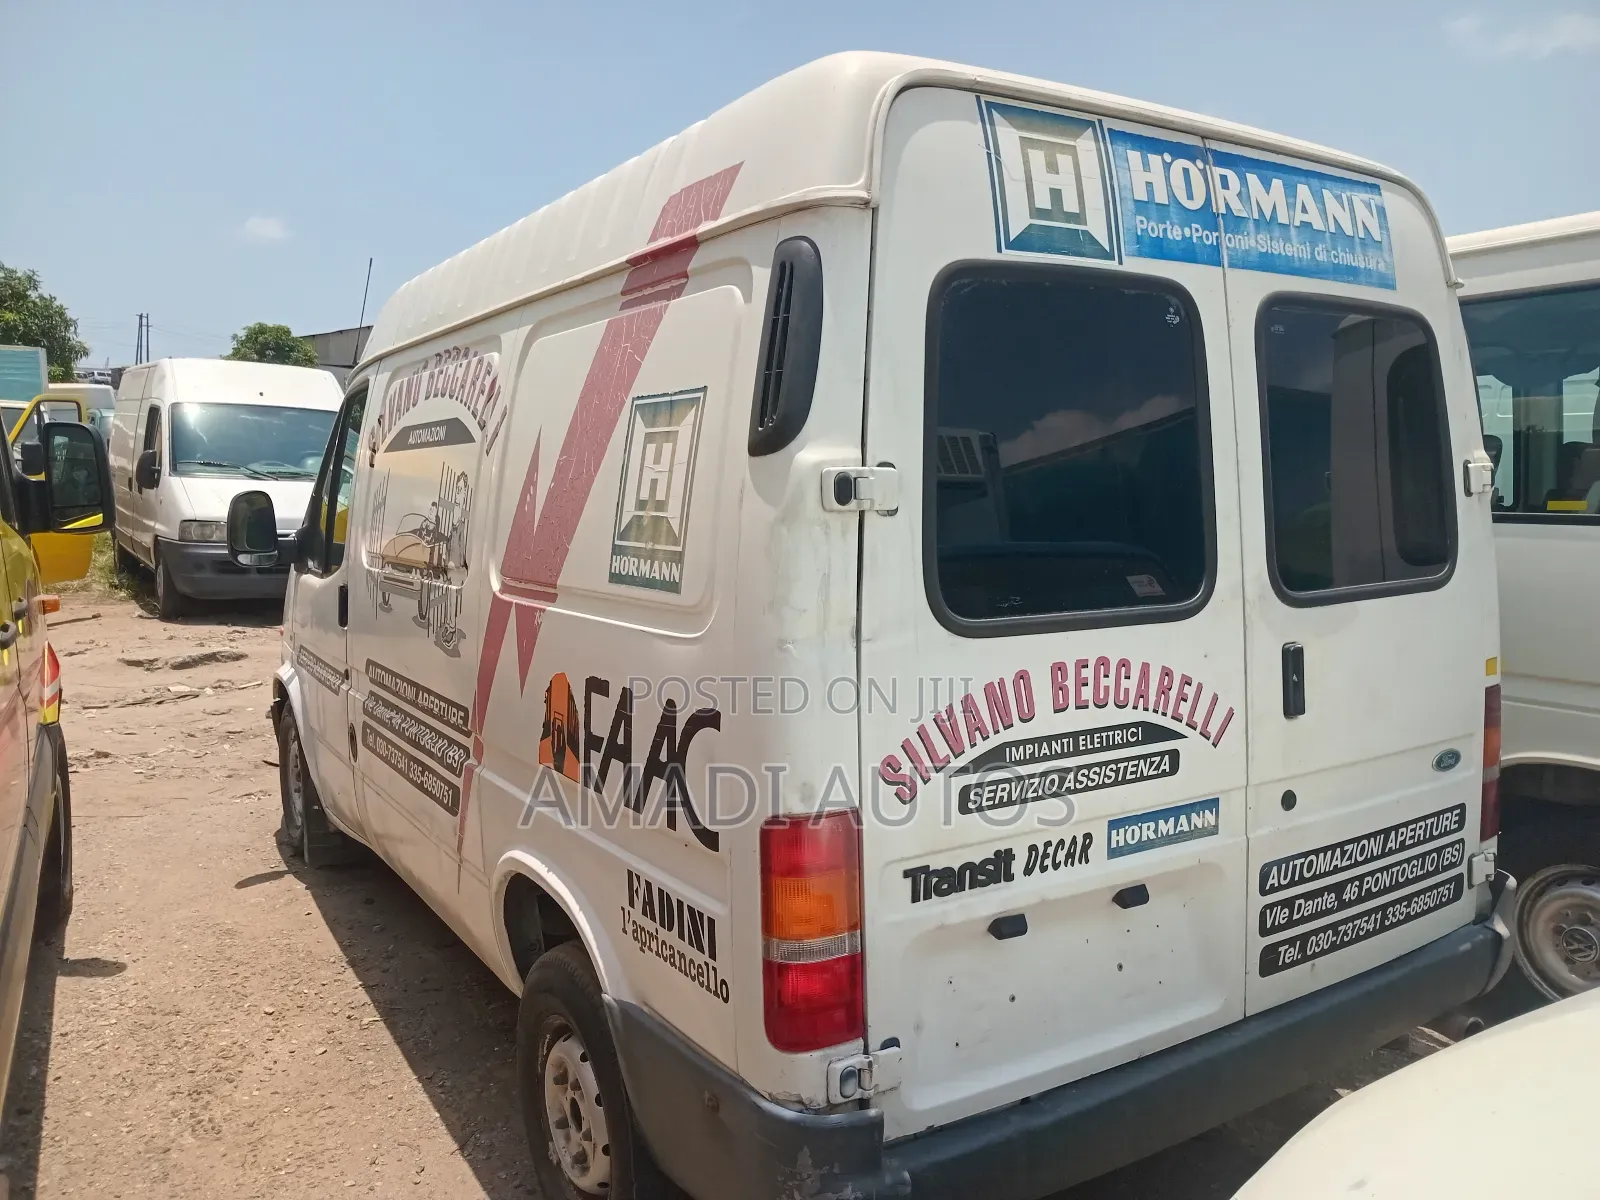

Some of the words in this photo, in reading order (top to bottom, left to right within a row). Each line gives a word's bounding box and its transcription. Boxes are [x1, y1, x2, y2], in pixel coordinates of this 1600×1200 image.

[1126, 149, 1382, 242] HÖRMANN
[1192, 223, 1248, 250] Poroni
[1314, 246, 1327, 263] di
[1330, 249, 1385, 273] chiusura
[408, 425, 447, 445] AUTOMAZIONI
[611, 554, 681, 583] HÖRMANN
[368, 665, 416, 703] AUTOMAZIONI
[366, 729, 376, 749] Tel.
[377, 737, 408, 774] 030-737541
[409, 762, 453, 807] 335-6850751
[583, 676, 721, 852] FAAC
[878, 669, 1036, 805] SILVANO
[1050, 655, 1235, 749] BECCARELLI
[1005, 738, 1073, 763] IMPIANTI
[1078, 727, 1142, 751] ELETTRICI
[967, 776, 1059, 810] SERVIZIO
[1061, 754, 1171, 793] ASSISTENZA
[902, 847, 1015, 904] Transit
[1022, 831, 1094, 877] DECAR
[1110, 807, 1216, 850] HÖRMANN
[1265, 834, 1384, 890] AUTOMAZIONI
[1385, 808, 1461, 853] APERTURE
[627, 868, 717, 962] FADINI
[1293, 890, 1338, 920] Dante,
[1343, 881, 1359, 903] 46
[1362, 855, 1437, 898] PONTOGLIO
[1439, 842, 1463, 872] (BS)
[620, 905, 730, 1004] l'apricancello
[1277, 945, 1303, 966] Tel.
[1306, 911, 1382, 956] 030-737541
[1384, 881, 1455, 925] 335-6850751
